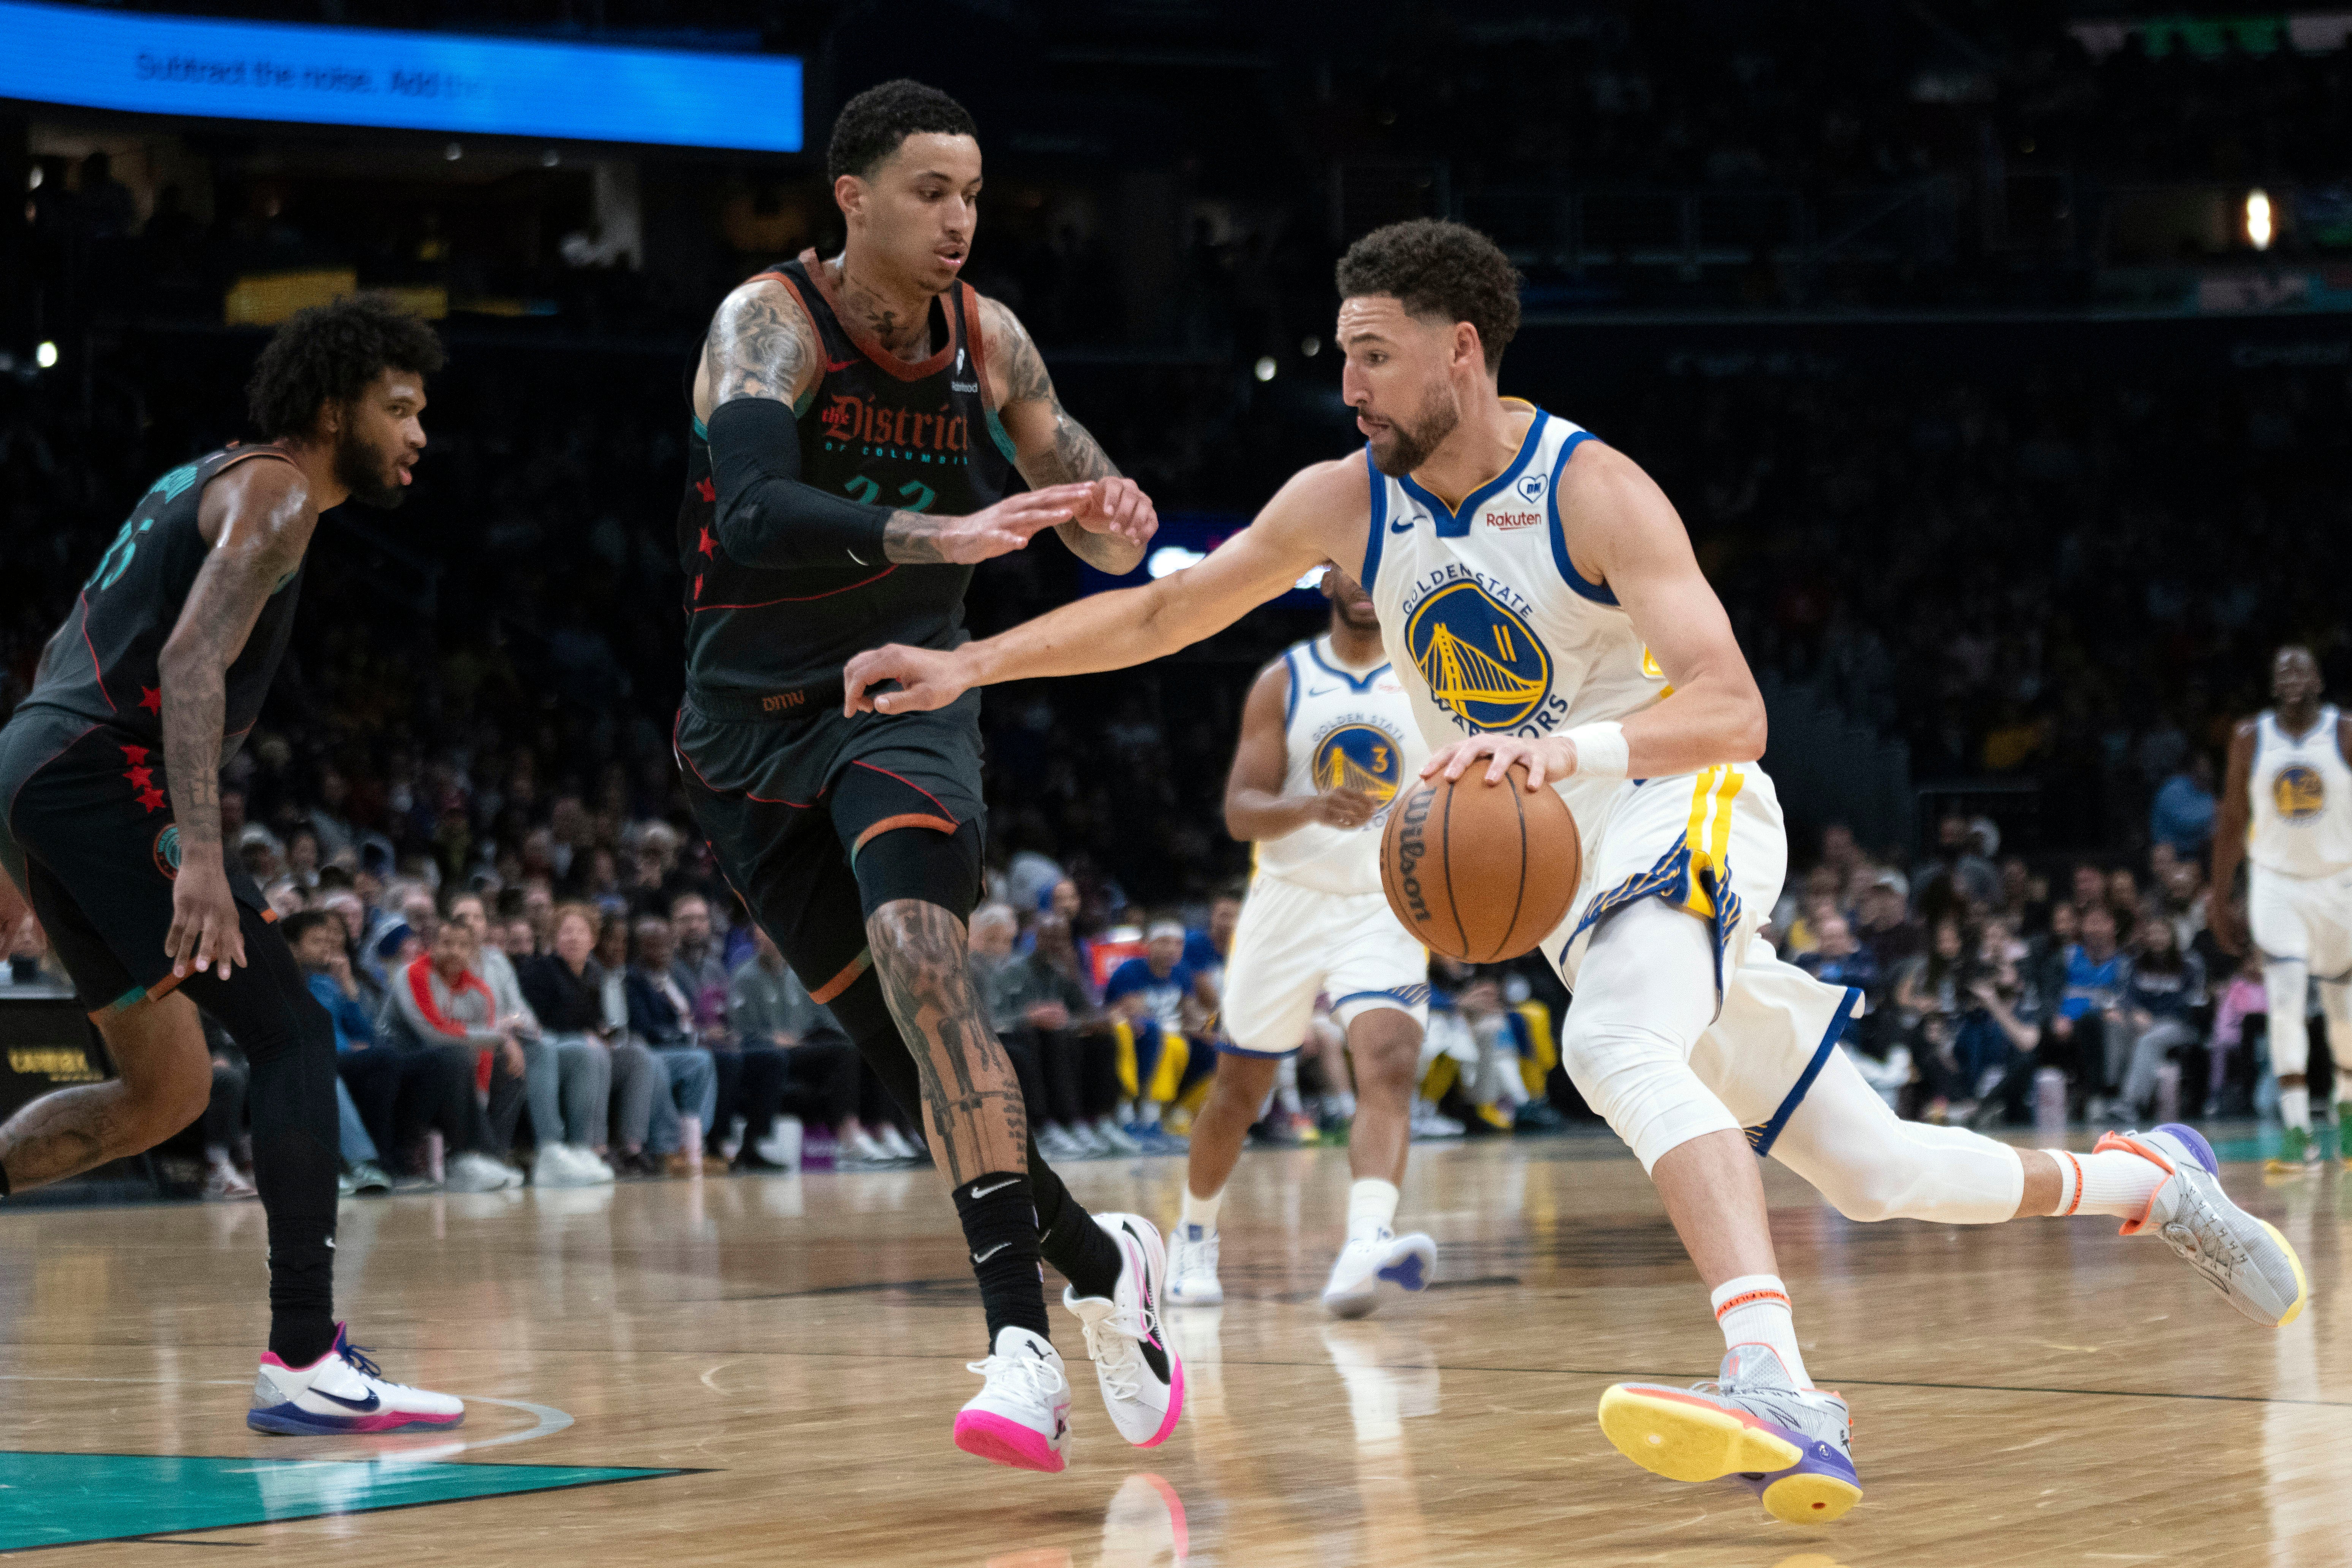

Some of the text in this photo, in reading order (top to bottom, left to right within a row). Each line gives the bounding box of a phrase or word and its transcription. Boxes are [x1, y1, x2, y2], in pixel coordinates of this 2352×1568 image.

[135, 52, 245, 84] Subtract
[254, 61, 292, 89] the
[390, 69, 439, 98] Add
[1486, 511, 1542, 528] Rakuten
[1402, 563, 1533, 619] GOLDEN STATE
[1492, 624, 1517, 662] 11
[1372, 745, 1389, 774] 3
[1399, 786, 1438, 923] Wilson
